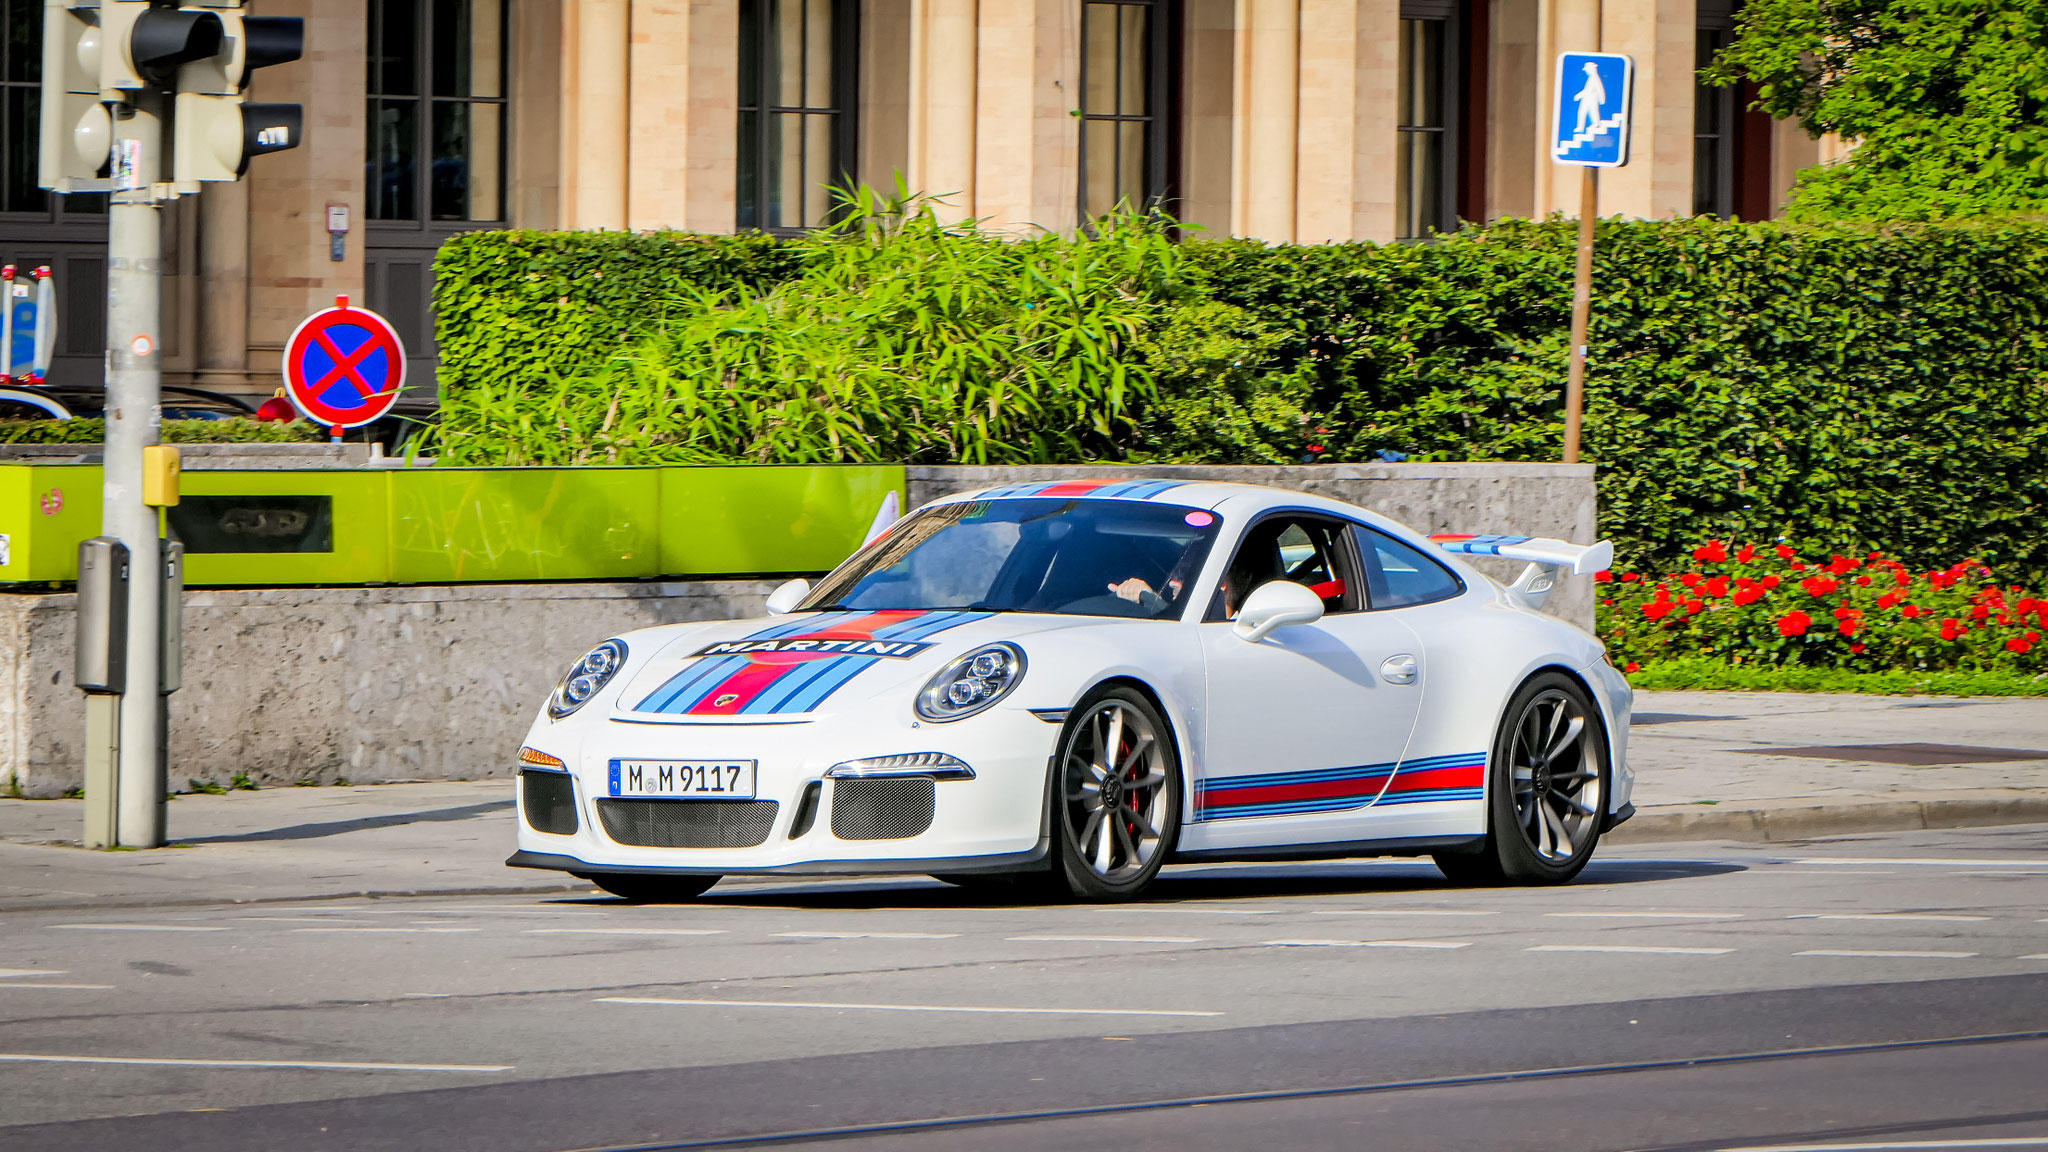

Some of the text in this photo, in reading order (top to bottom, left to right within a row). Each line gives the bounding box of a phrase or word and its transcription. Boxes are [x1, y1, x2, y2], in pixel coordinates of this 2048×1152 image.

[704, 640, 918, 656] MARTINI
[629, 765, 643, 792] M
[680, 765, 741, 792] 9117
